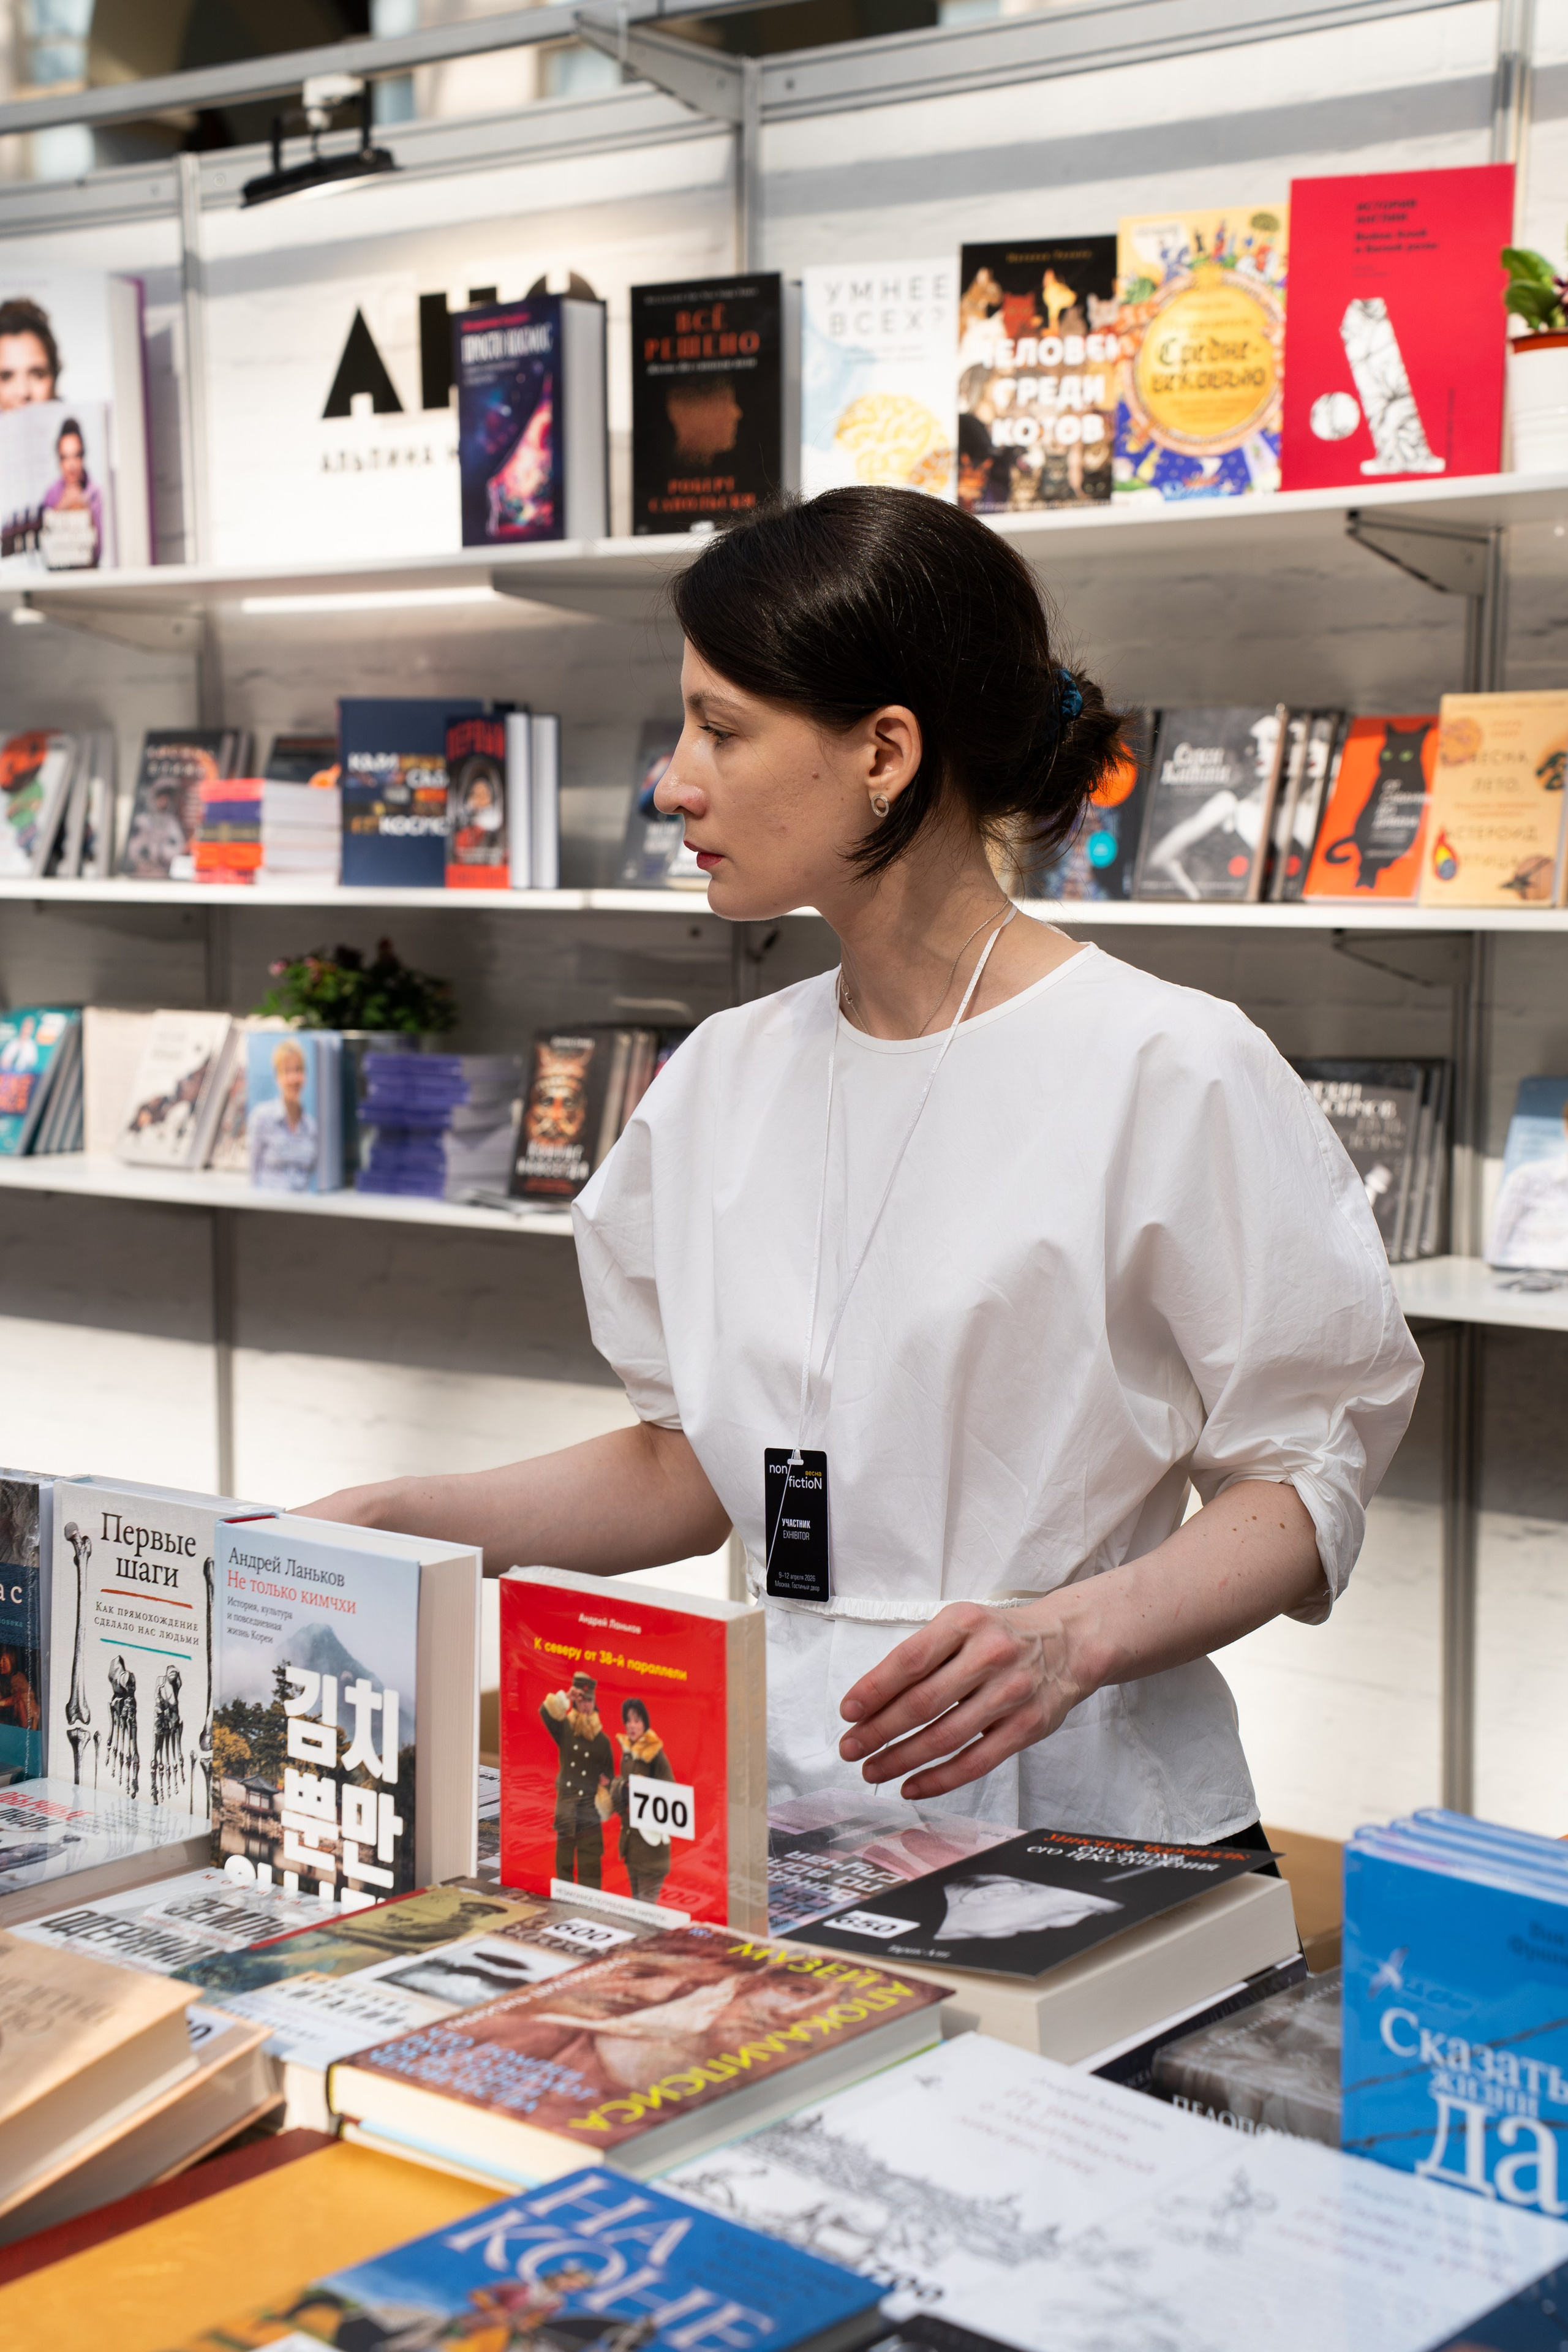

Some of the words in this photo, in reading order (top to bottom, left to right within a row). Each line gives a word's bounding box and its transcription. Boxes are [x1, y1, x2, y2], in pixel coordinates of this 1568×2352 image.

[824, 273, 950, 306] УМНЕЕ
[676, 303, 727, 334] ВСЁ
[644, 329, 760, 361] РЕШЕНО
[992, 374, 1105, 411] СРЕДИ
[991, 413, 1104, 447] КОТОВ
[769, 1464, 788, 1474] non
[788, 1476, 822, 1490] fictioN
[100, 1512, 197, 1558] Первые
[782, 1518, 810, 1529] УЧАСТНИК
[783, 1529, 810, 1540] EXHIBITOR
[115, 1557, 179, 1589] шаги
[228, 1547, 281, 1575] Андрей
[285, 1559, 345, 1588] Ланьков
[227, 1569, 246, 1588] Не
[249, 1577, 297, 1602] только
[300, 1589, 357, 1615] кимчхи
[0, 1618, 23, 1627] овека
[227, 1596, 259, 1613] История,
[260, 1603, 293, 1622] культура
[233, 1613, 282, 1632] повседневная
[578, 1613, 608, 1629] Андрей
[609, 1618, 641, 1635] Ланьков
[226, 1624, 249, 1640] жизнь
[251, 1629, 274, 1645] Кореи
[534, 1637, 542, 1650] К
[544, 1640, 582, 1661] северу
[584, 1648, 597, 1660] от
[599, 1649, 625, 1667] 38-й
[627, 1658, 687, 1681] параллели
[283, 1666, 400, 1785] 김치
[633, 1792, 688, 1828] 700
[281, 1767, 404, 1890] 뿐만
[1027, 1845, 1063, 1856] его
[767, 1856, 832, 1879] вол
[767, 1870, 862, 1903] Вожд
[554, 1923, 612, 1942] 600
[835, 1915, 897, 1932] 650
[728, 1941, 887, 1988] МУЗЕЙ
[568, 1979, 916, 2132] АПОКАЛИПСИСА
[1380, 2007, 1568, 2103] Сказать
[1429, 2067, 1539, 2117] жизни
[1415, 2093, 1568, 2217] Да
